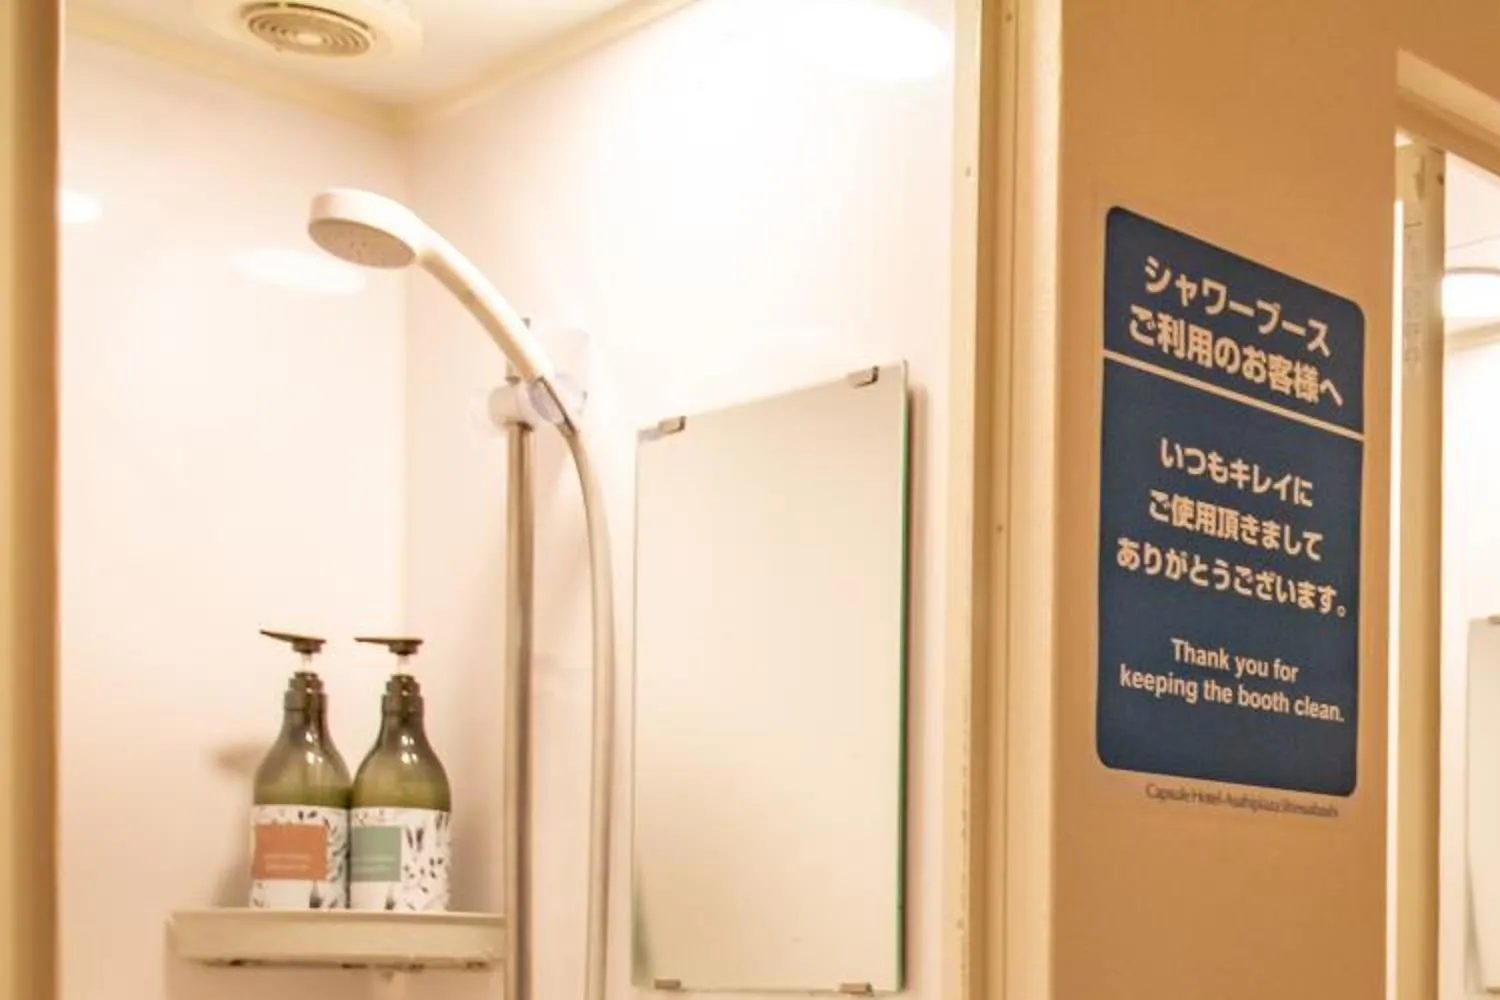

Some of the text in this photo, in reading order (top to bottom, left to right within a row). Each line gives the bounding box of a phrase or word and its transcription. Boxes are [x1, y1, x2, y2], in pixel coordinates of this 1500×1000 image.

[1144, 255, 1331, 357] シャワーブース
[1128, 304, 1344, 406] ご利用のお客様へ
[1160, 437, 1314, 507] いつもキレイに
[1150, 489, 1324, 561] ご使用頂きまして
[1116, 537, 1347, 617] ありがとうございます。
[1119, 663, 1345, 722] keeping the booth clean.
[1170, 638, 1299, 682] Thank you for
